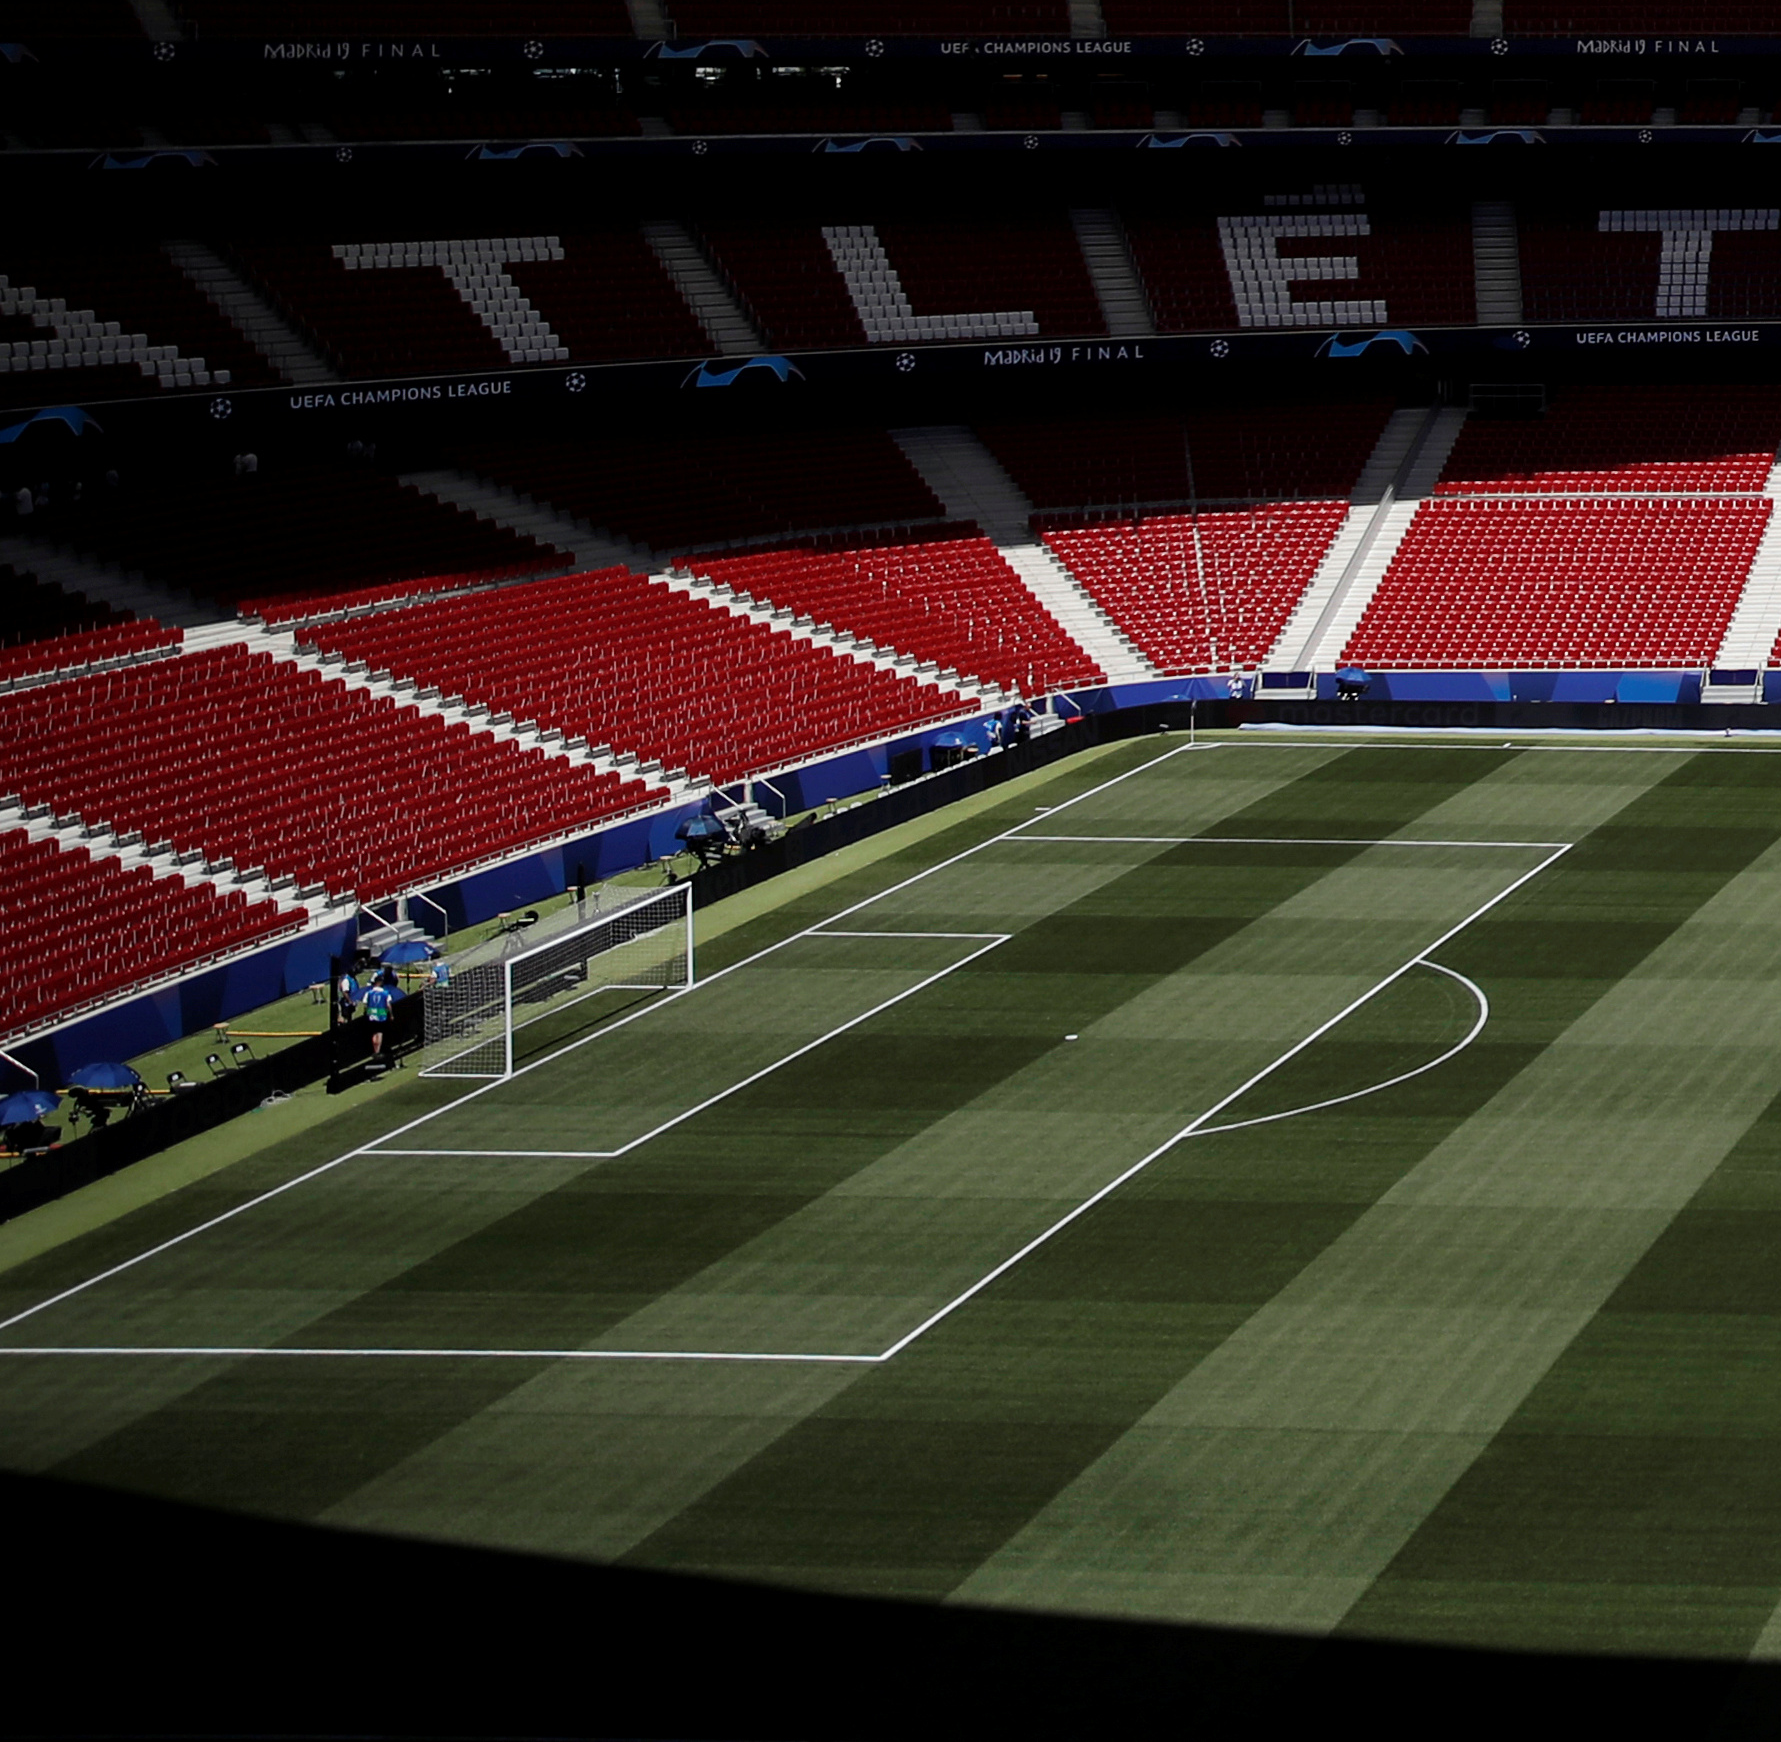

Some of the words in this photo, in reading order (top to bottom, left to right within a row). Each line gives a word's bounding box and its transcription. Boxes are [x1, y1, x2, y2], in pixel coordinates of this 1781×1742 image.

[337, 42, 350, 60] 19
[362, 43, 440, 58] FINAL
[975, 41, 1071, 54] CHAMPIONS
[1076, 41, 1132, 54] LEAGUE
[1635, 39, 1646, 55] 19
[1655, 40, 1719, 53] FINAL
[1576, 332, 1614, 344] UEFA
[1617, 330, 1701, 344] CHAMPIONS
[1706, 330, 1760, 342] LEAGUE
[1049, 346, 1062, 365] 19
[1072, 345, 1144, 361] FINAL
[290, 395, 336, 410] UEFA
[340, 385, 441, 406] CHAMPIONS
[448, 381, 511, 398] LEAGUE
